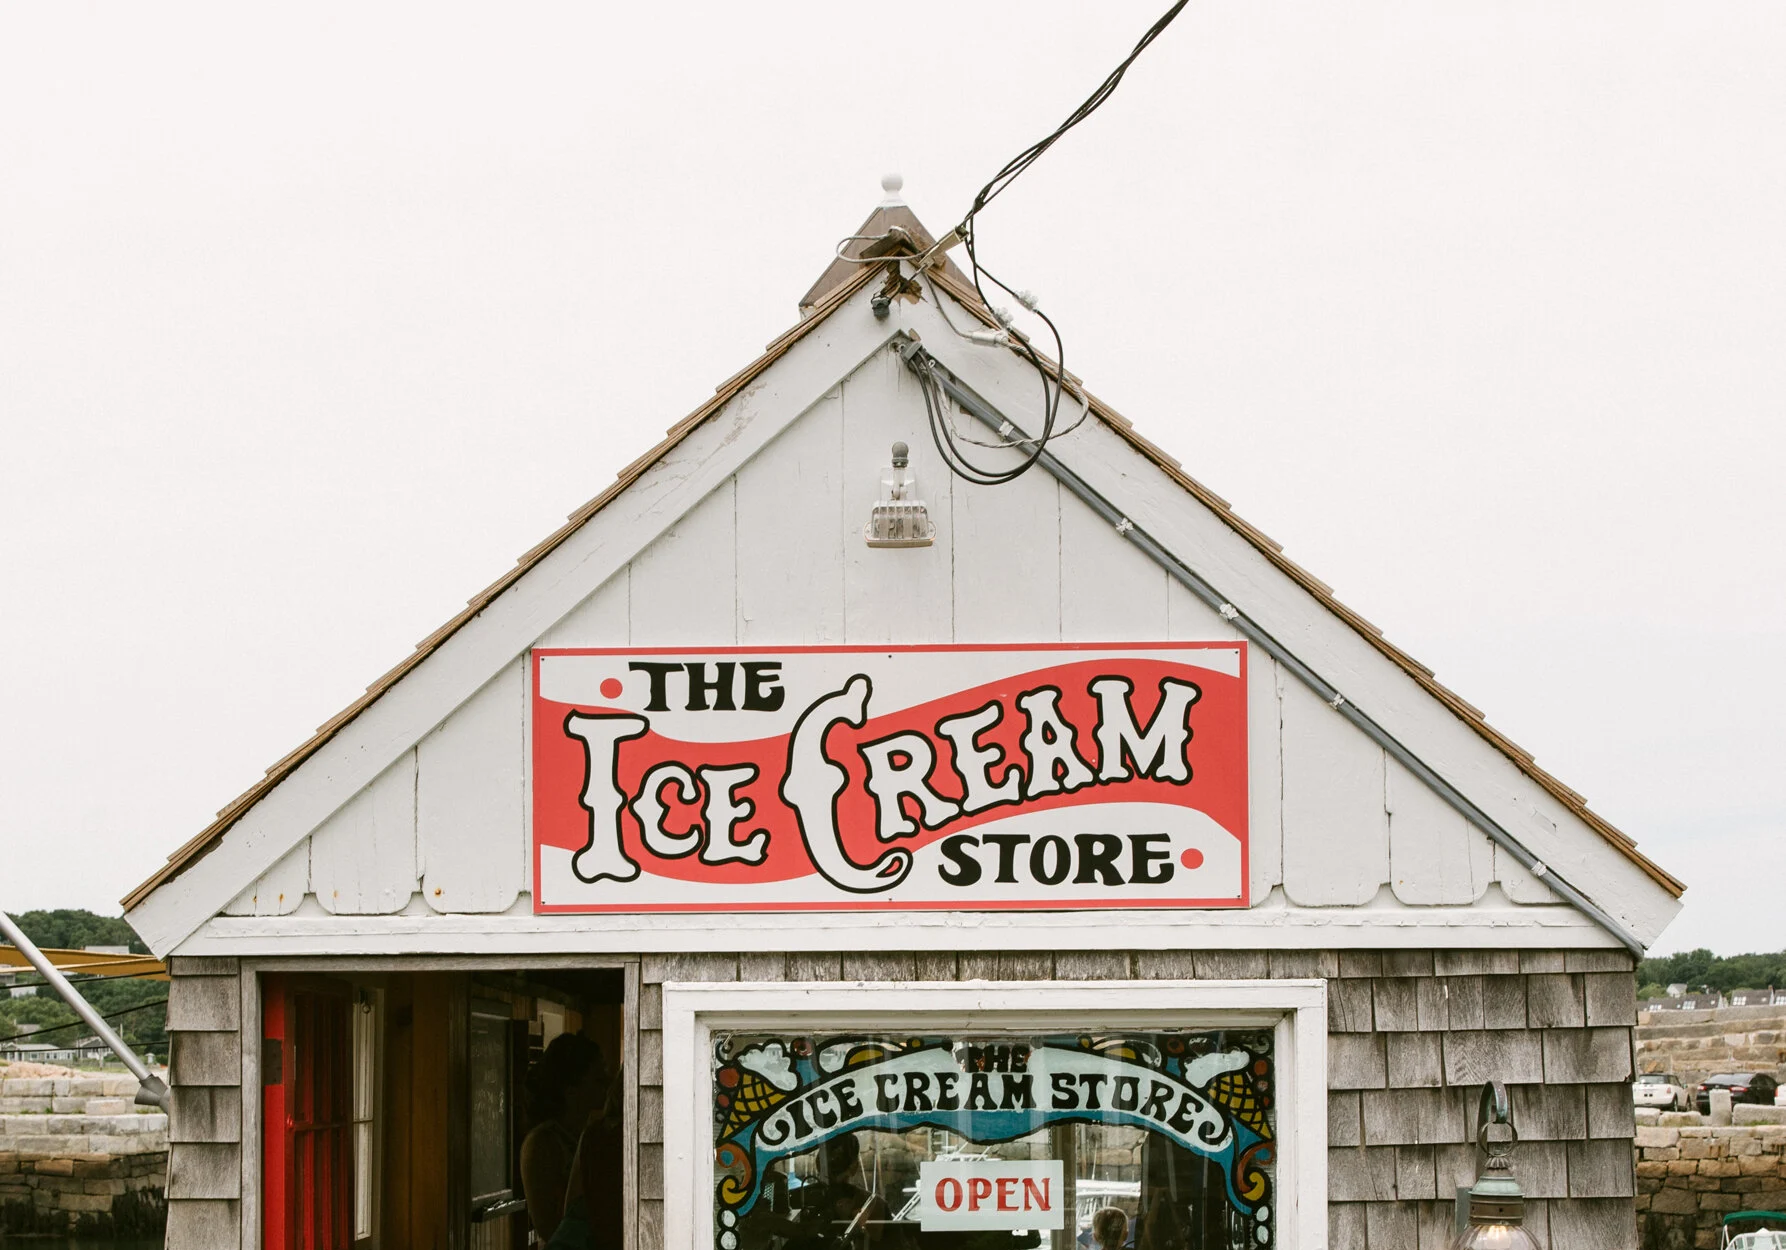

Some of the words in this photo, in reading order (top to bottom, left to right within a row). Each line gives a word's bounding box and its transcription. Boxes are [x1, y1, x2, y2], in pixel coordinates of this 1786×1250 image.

[628, 661, 785, 712] THE
[938, 832, 1175, 886] STORE
[955, 1044, 1031, 1073] THE
[786, 1078, 864, 1139] ICE
[873, 1071, 1036, 1112] CREAM
[1050, 1073, 1204, 1134] STORE
[935, 1177, 1052, 1212] OPEN
